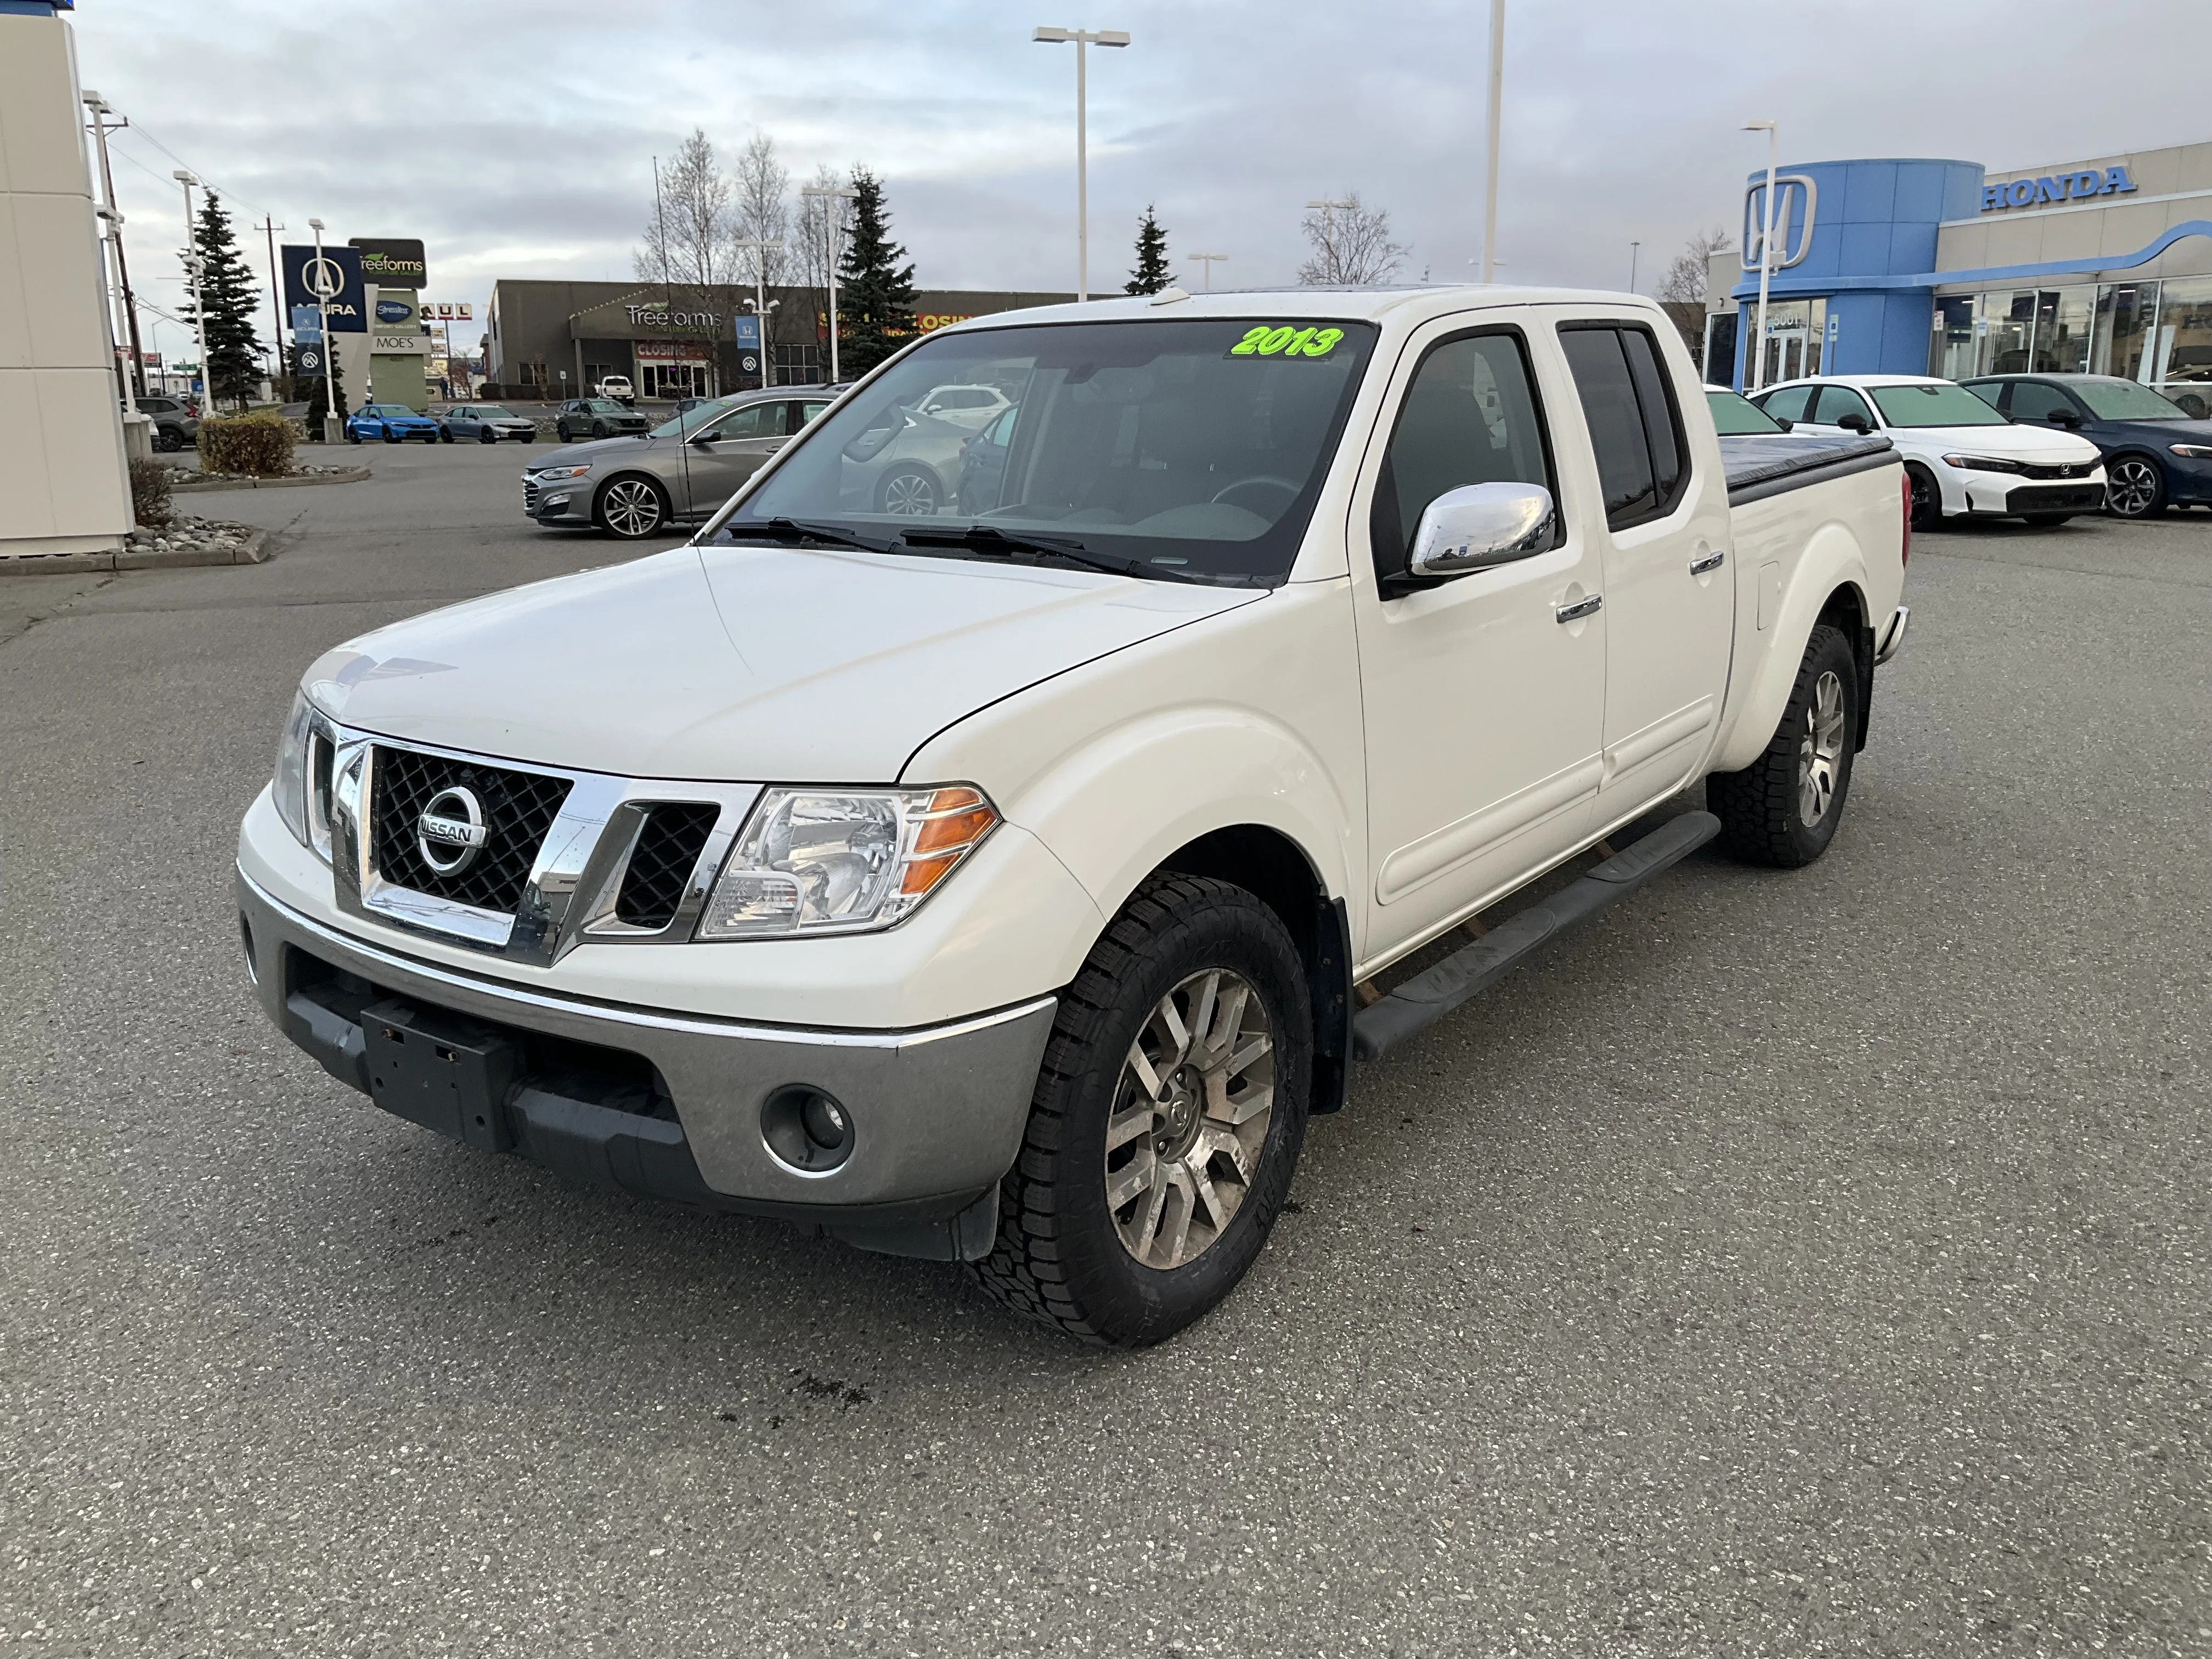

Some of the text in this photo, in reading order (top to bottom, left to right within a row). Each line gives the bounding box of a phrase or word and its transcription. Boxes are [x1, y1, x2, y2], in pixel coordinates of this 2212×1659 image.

[1981, 166, 2135, 210] HONDA
[360, 256, 423, 270] reeforms
[377, 305, 408, 314] Stressless
[1774, 310, 1799, 326] 5001
[377, 337, 414, 348] MOE'S
[1231, 326, 1344, 357] 2013
[637, 343, 687, 356] CLOSING
[419, 816, 472, 842] NISSAN
